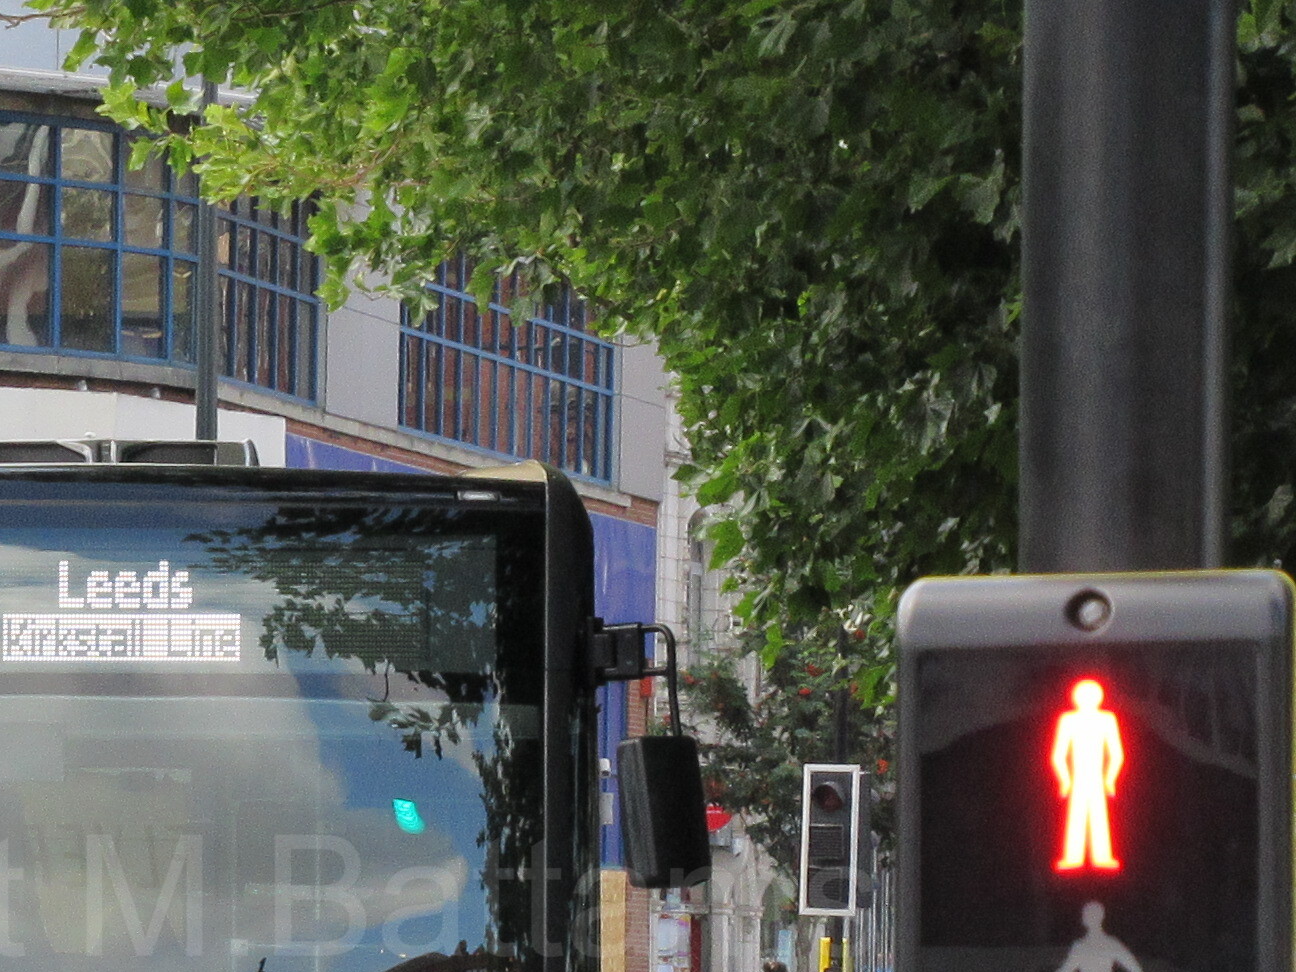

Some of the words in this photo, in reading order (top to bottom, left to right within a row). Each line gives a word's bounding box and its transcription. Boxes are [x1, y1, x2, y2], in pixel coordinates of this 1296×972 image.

[58, 560, 194, 609] Leeds
[6, 618, 141, 658] Kirkstall
[167, 618, 240, 658] Line
